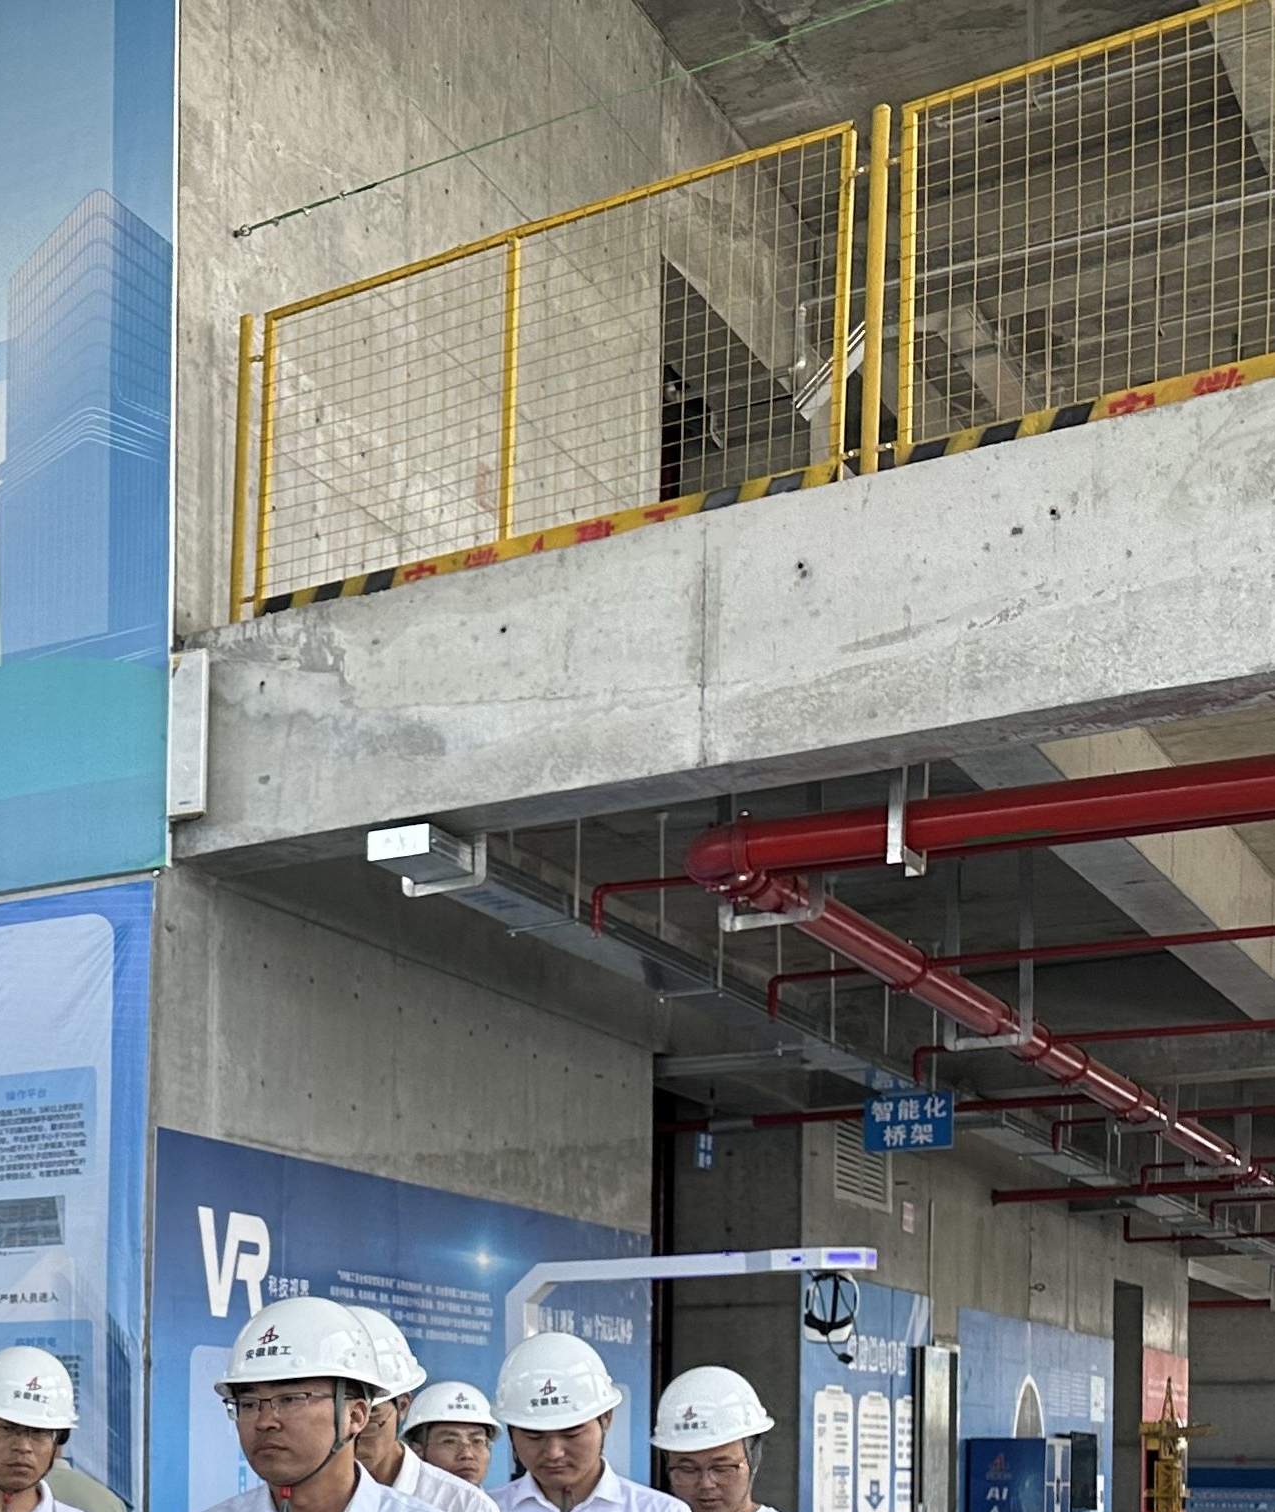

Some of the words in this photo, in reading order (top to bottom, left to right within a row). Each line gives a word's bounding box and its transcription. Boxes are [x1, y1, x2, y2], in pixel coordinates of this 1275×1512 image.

[871, 1096, 947, 1122] 智能化
[883, 1123, 934, 1149] 桥架
[197, 1205, 270, 1317] VR
[244, 1344, 292, 1360] 安徽建工
